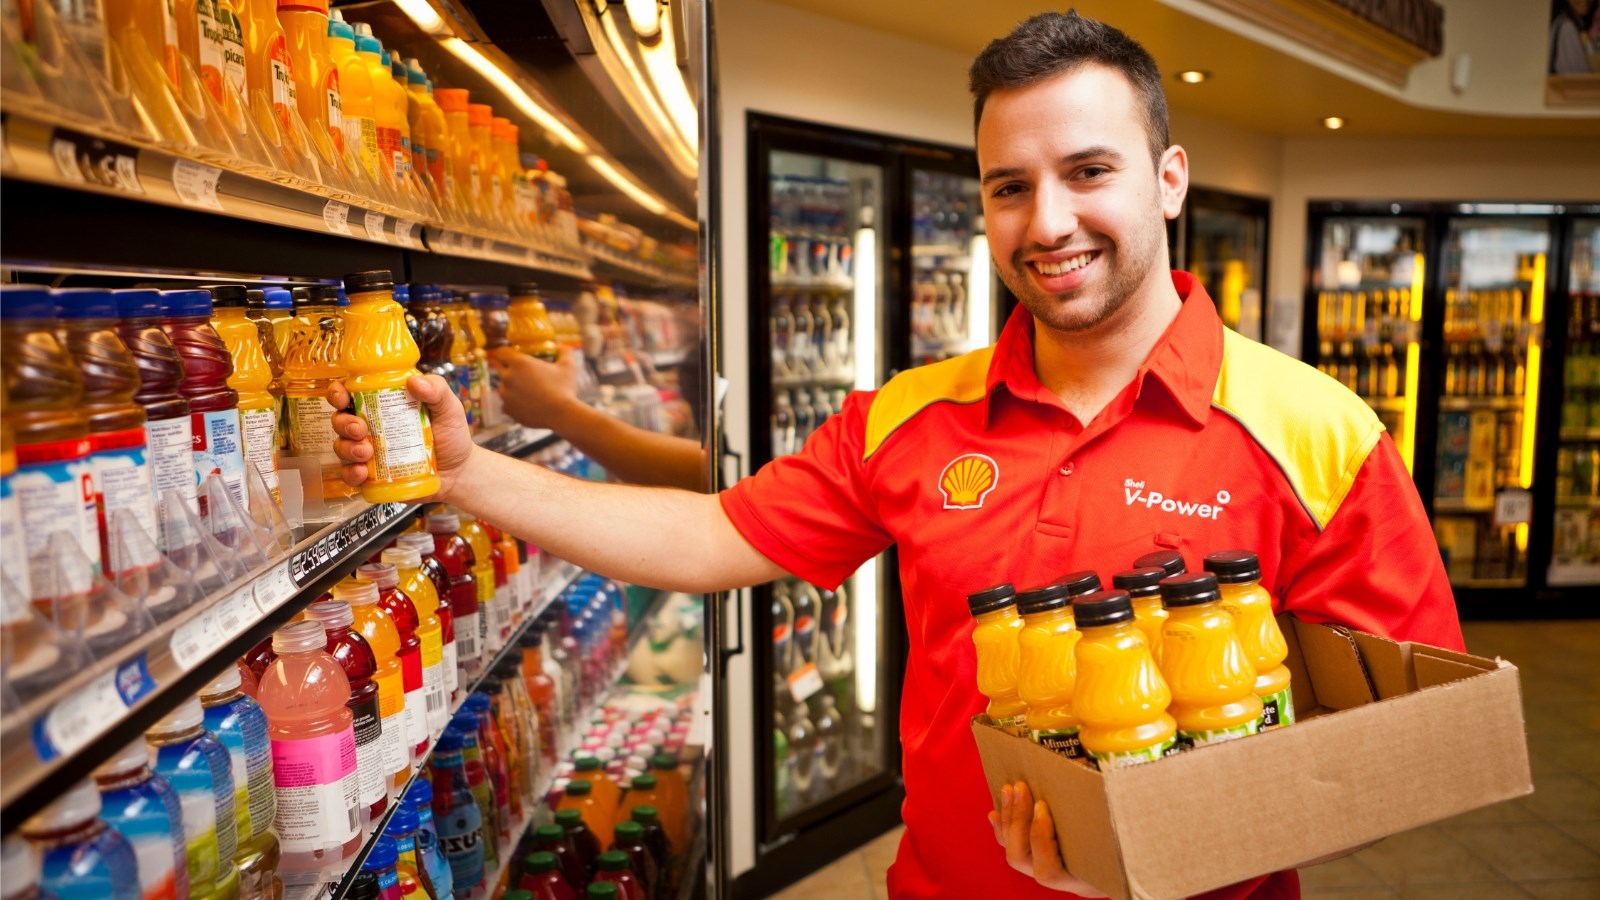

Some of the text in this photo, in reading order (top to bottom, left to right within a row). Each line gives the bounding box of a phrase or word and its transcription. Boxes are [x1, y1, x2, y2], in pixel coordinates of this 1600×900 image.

[1124, 478, 1146, 489] Shell
[1125, 488, 1223, 520] V-Power
[301, 545, 321, 575] 2.59
[1043, 738, 1080, 749] Minute
